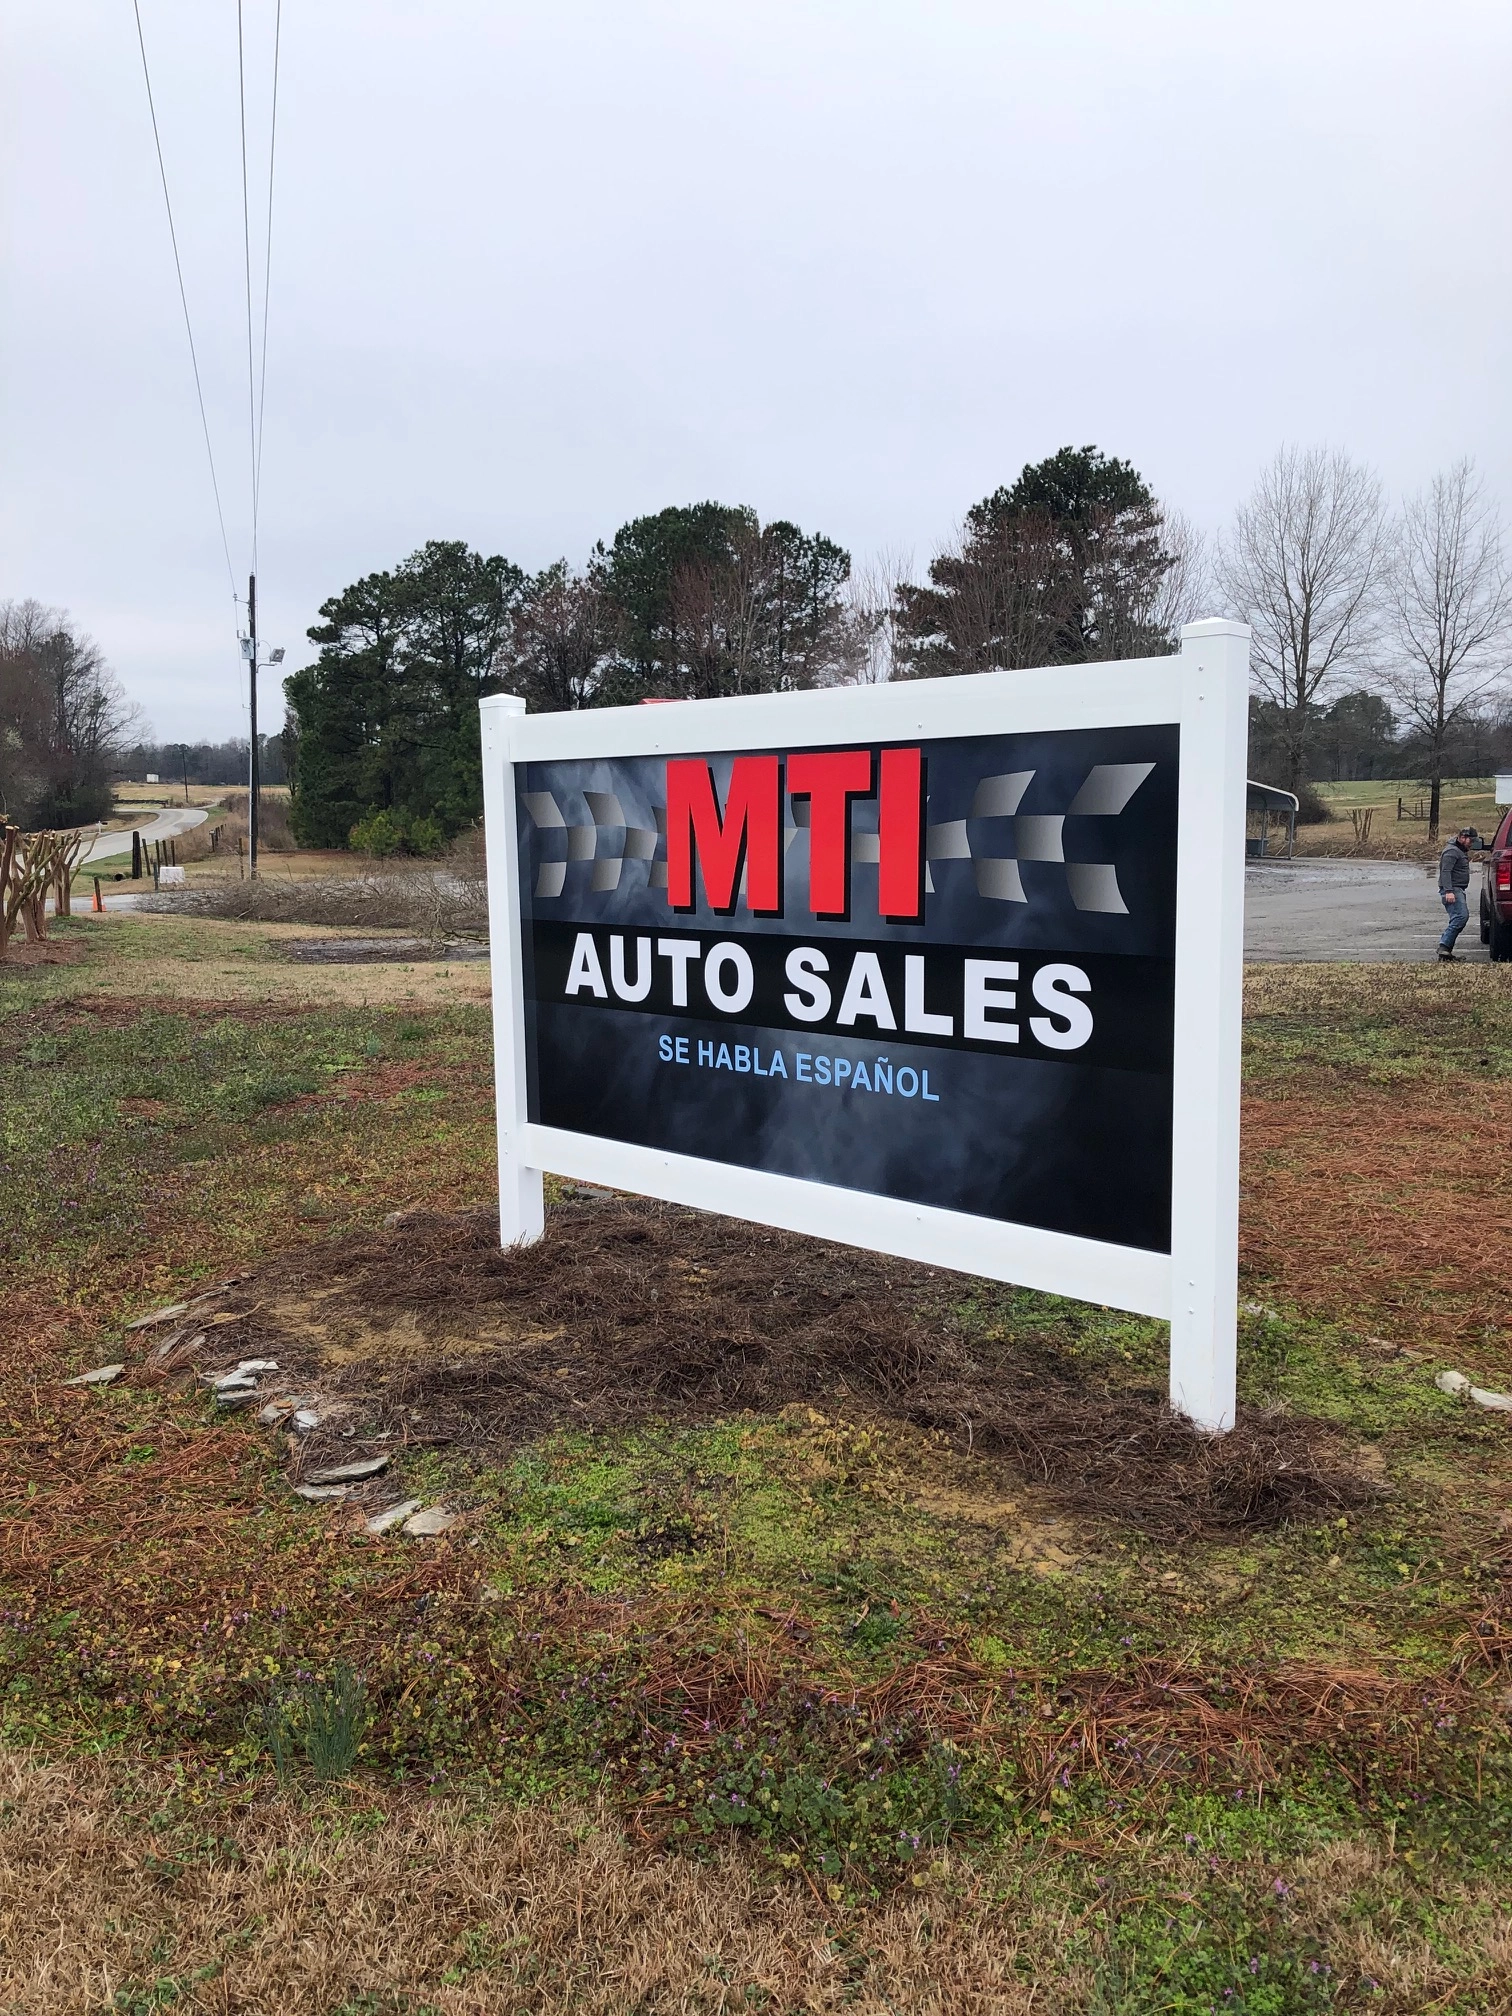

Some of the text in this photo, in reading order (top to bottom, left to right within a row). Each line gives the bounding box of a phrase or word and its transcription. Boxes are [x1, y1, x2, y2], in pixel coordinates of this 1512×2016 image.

[666, 748, 923, 921] MTI
[565, 932, 1094, 1050] AUTO SALES
[658, 1034, 940, 1102] SE HABLA ESPAÑOL
